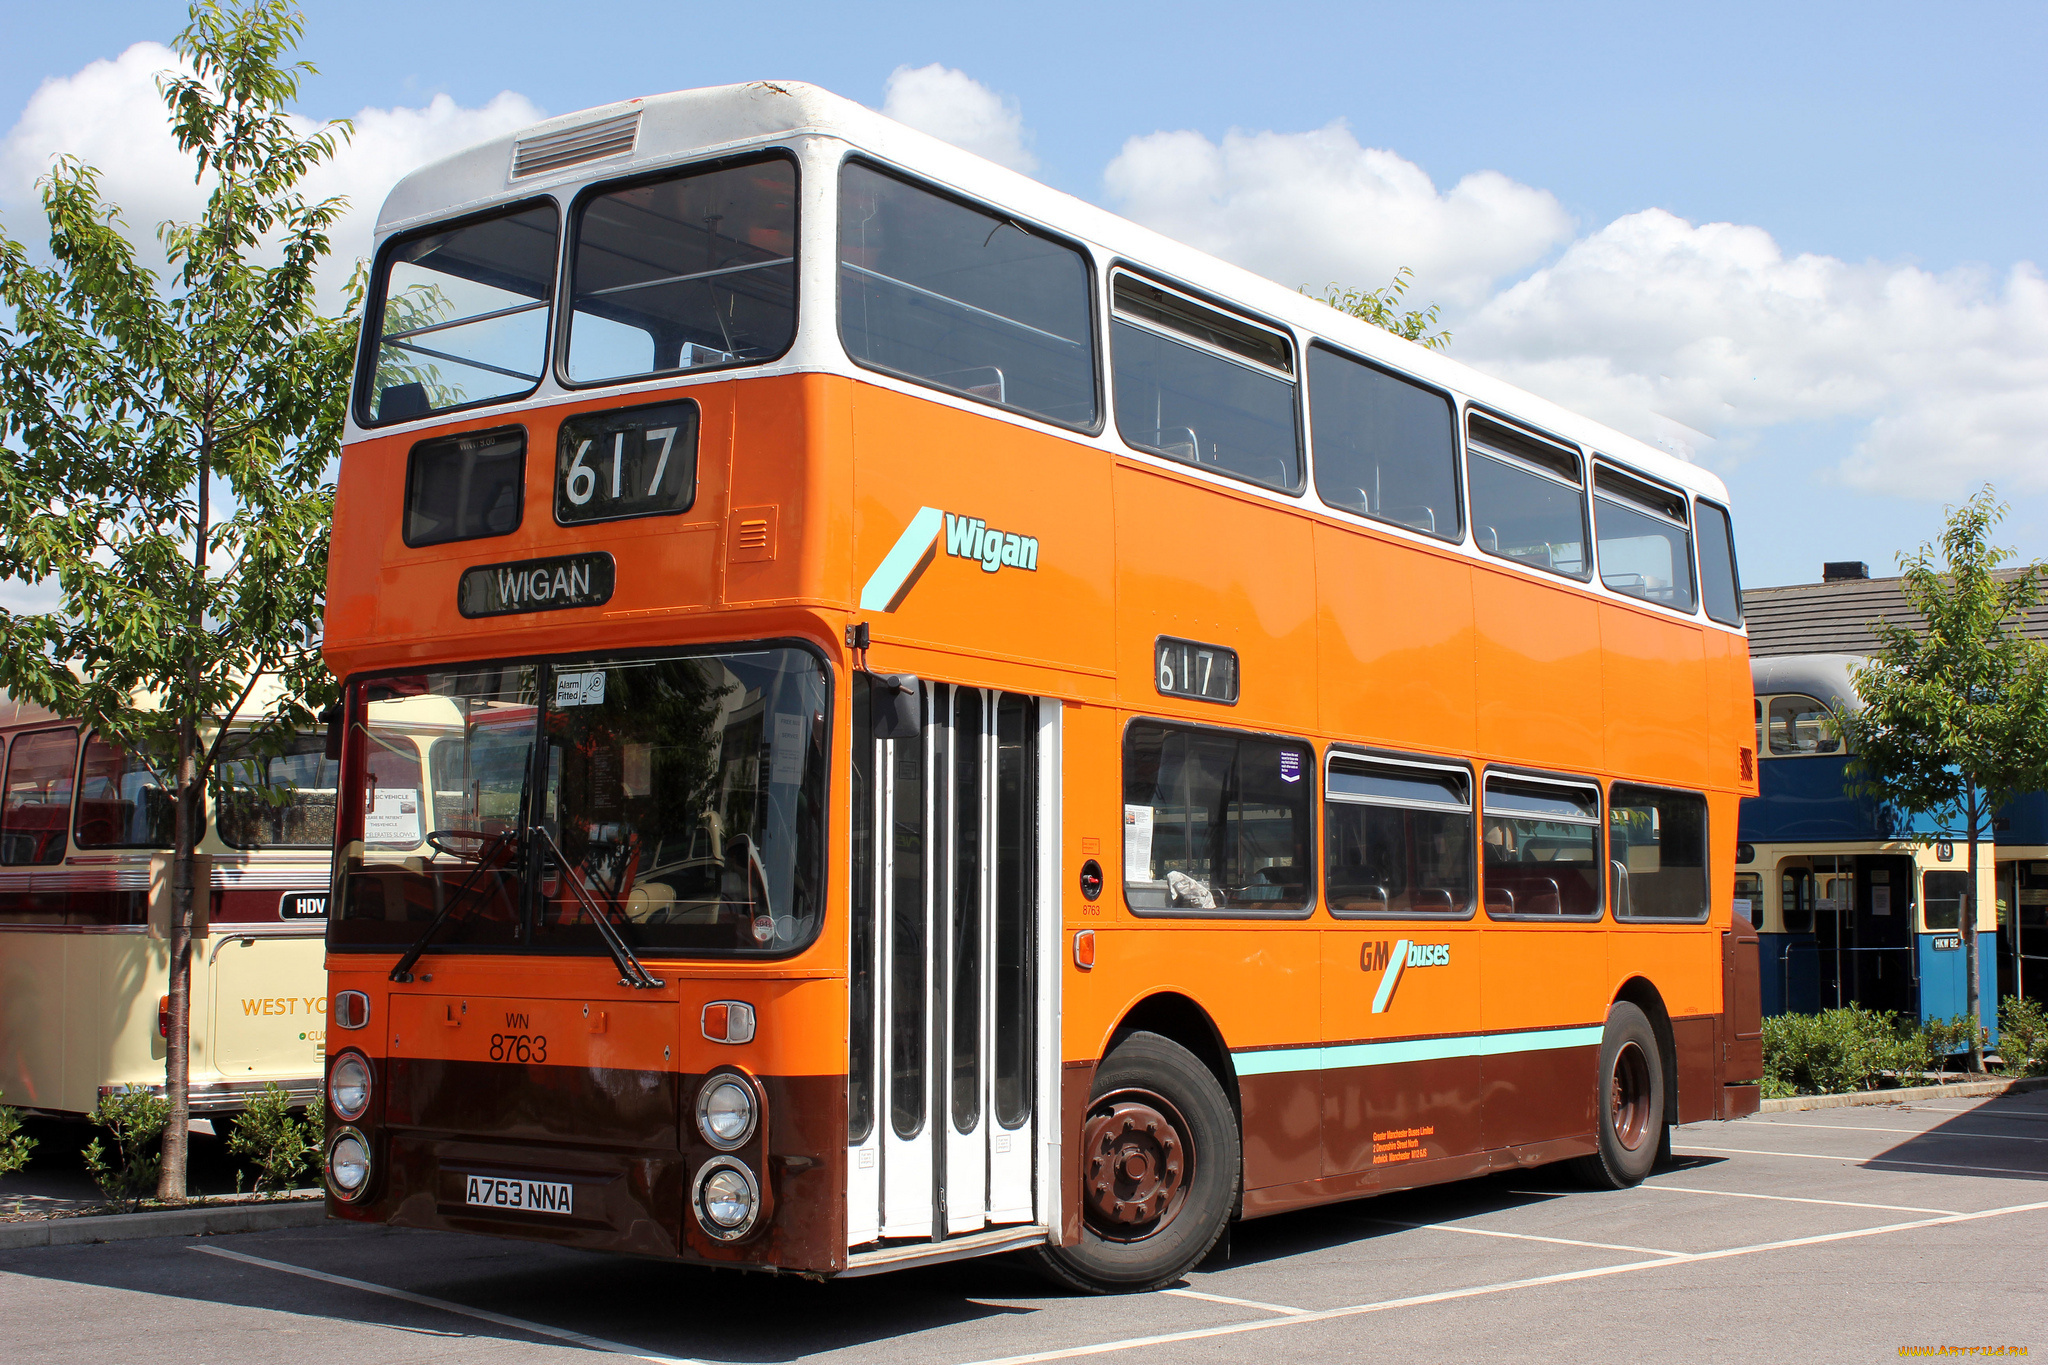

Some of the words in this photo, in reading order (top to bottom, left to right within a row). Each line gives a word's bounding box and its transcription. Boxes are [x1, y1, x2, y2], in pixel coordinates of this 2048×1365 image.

[566, 426, 678, 505] 617
[944, 511, 1039, 574] Wigan
[498, 563, 590, 604] WIGAN
[1160, 645, 1214, 695] 617
[557, 691, 579, 701] Fitted
[558, 680, 580, 690] Alarm
[1938, 843, 1951, 857] 79
[296, 898, 326, 914] HDV
[1083, 905, 1100, 915] 8763
[1360, 940, 1390, 972] GM
[1406, 940, 1450, 968] buses
[241, 997, 298, 1016] WEST
[505, 1012, 529, 1029] WN
[489, 1033, 547, 1063] 8763
[468, 1178, 523, 1206] A763
[528, 1183, 571, 1211] NNA
